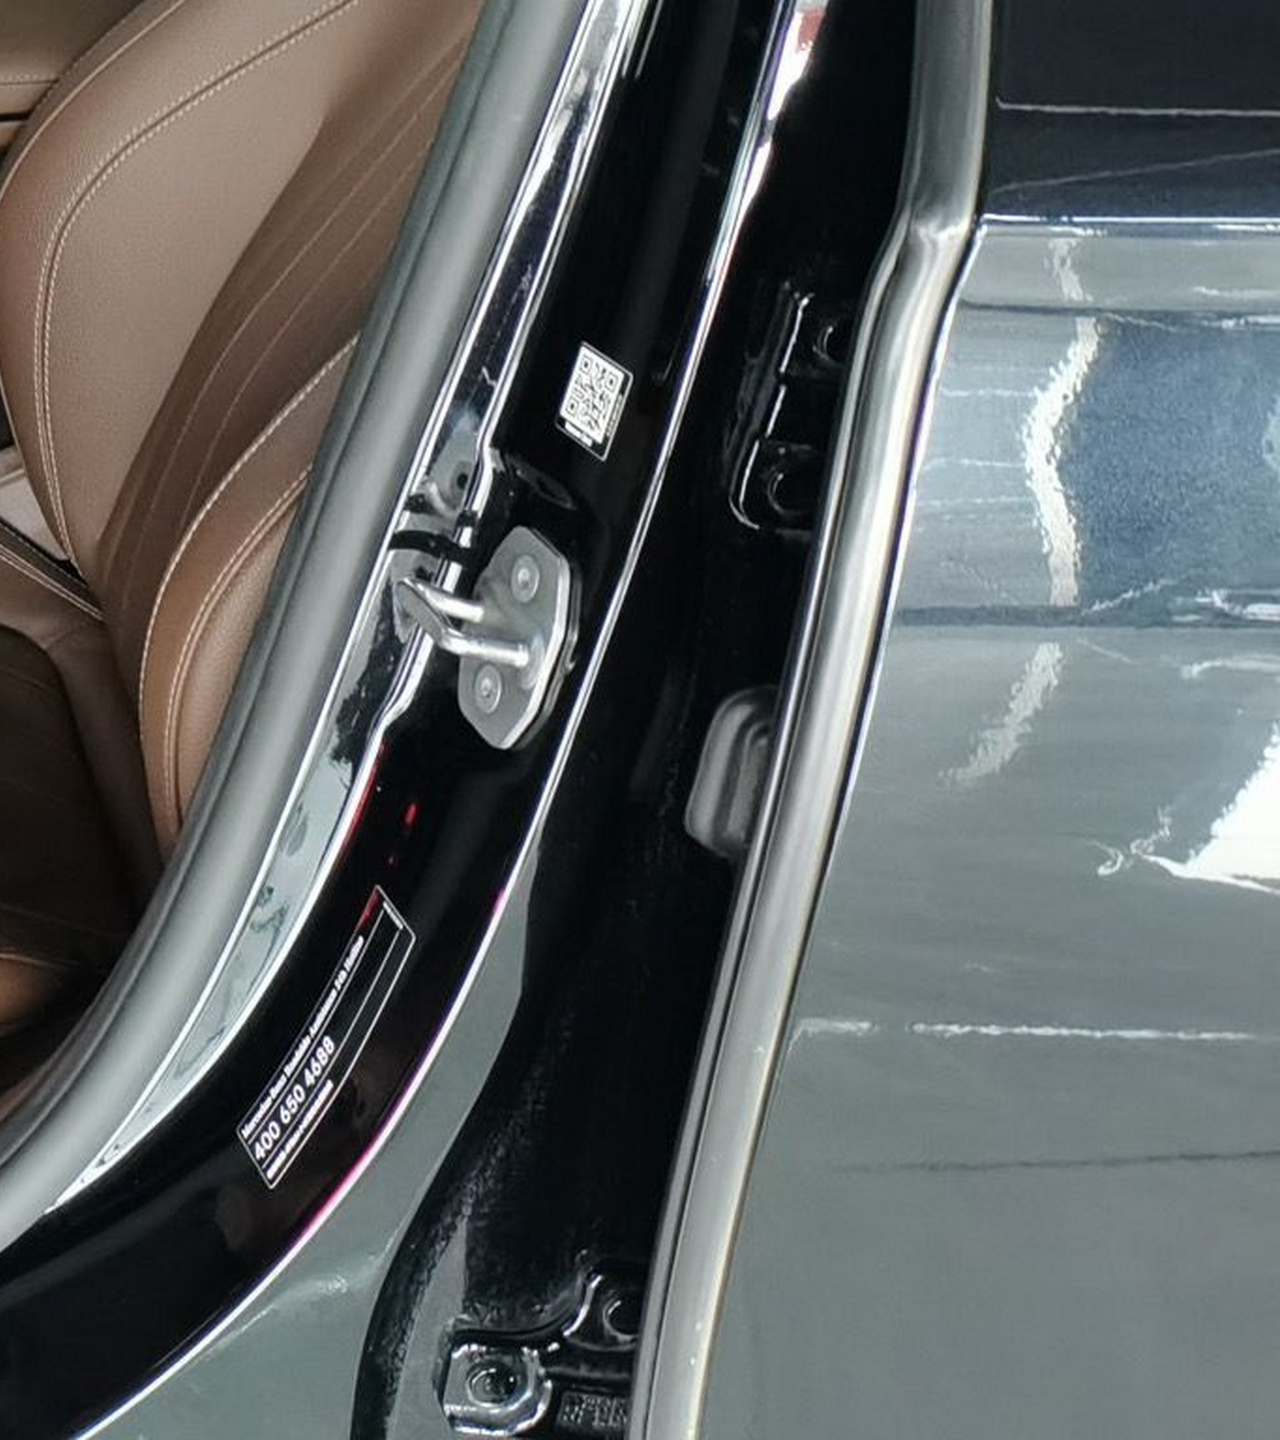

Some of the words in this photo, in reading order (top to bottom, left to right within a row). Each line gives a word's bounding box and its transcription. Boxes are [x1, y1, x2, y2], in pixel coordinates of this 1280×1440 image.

[254, 1120, 281, 1161] 400
[279, 1084, 306, 1134] 650
[304, 1035, 335, 1088] 4688
